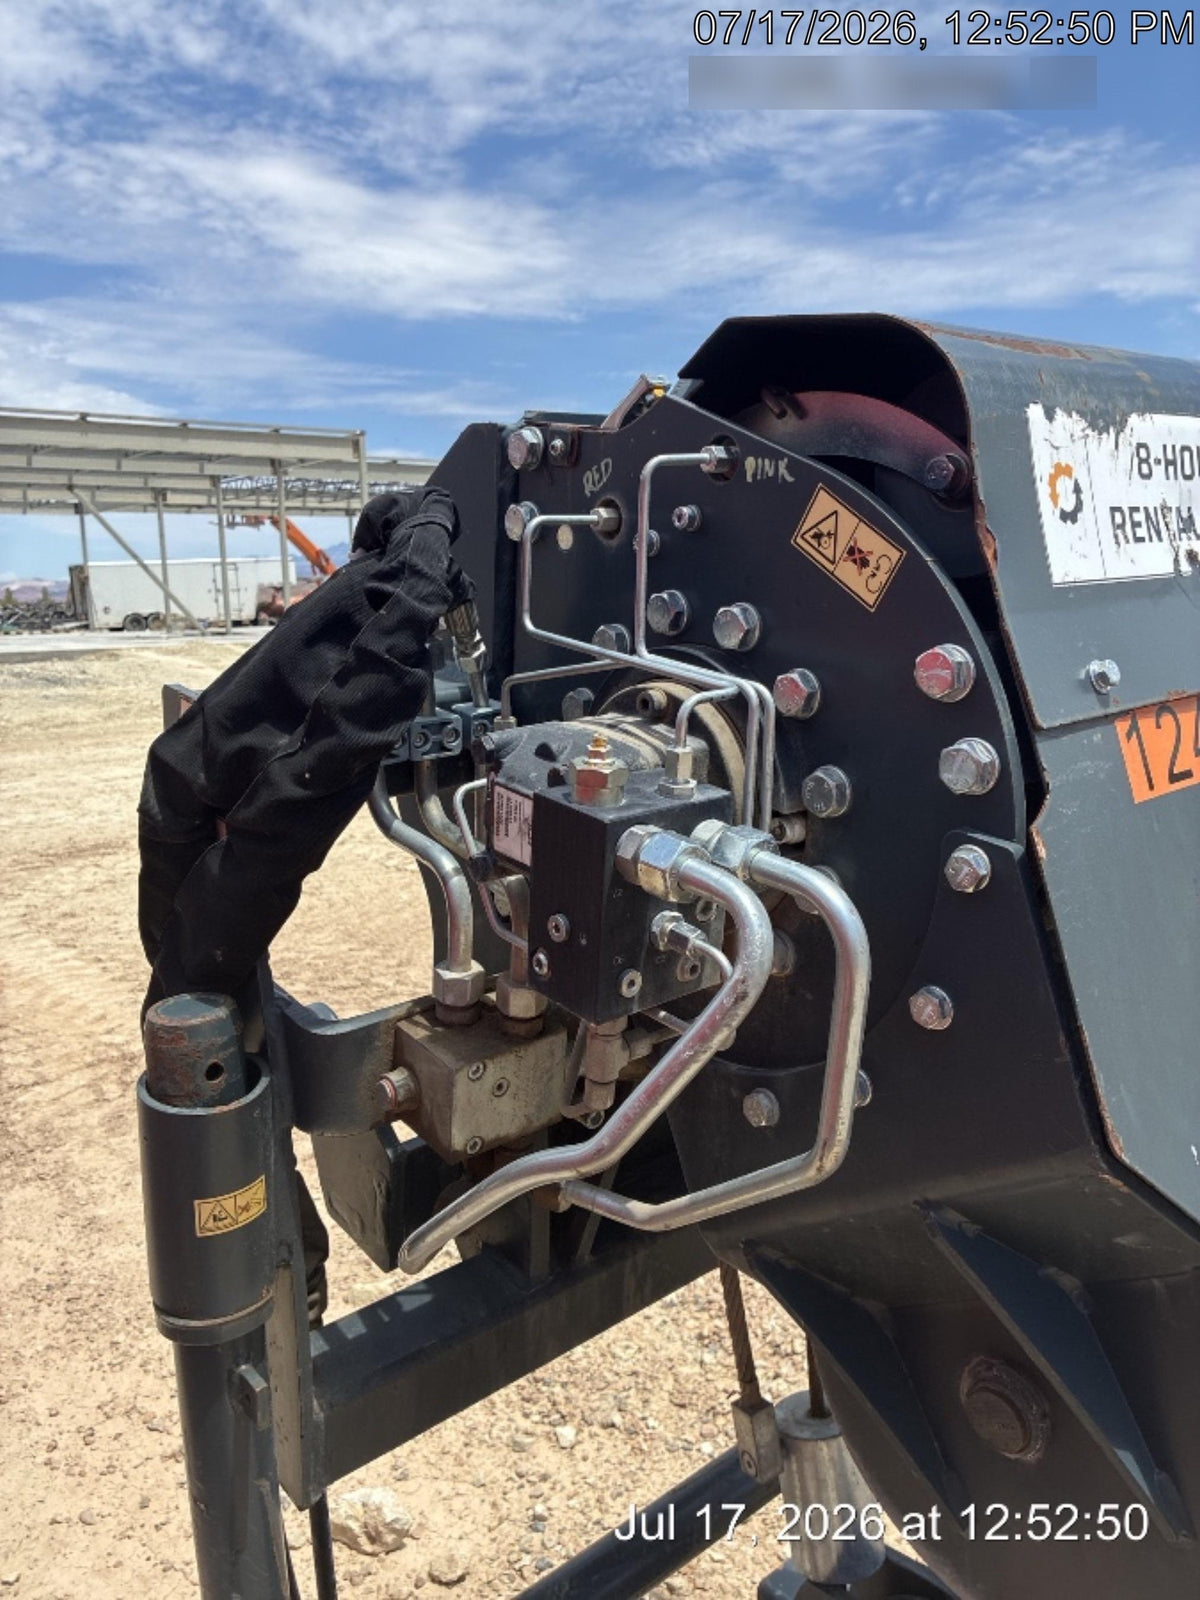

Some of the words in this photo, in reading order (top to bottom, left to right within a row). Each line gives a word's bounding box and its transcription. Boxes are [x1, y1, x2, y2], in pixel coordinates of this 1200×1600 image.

[582, 458, 612, 496] RED
[744, 456, 795, 483] PINK
[1135, 442, 1200, 481] 8-HO
